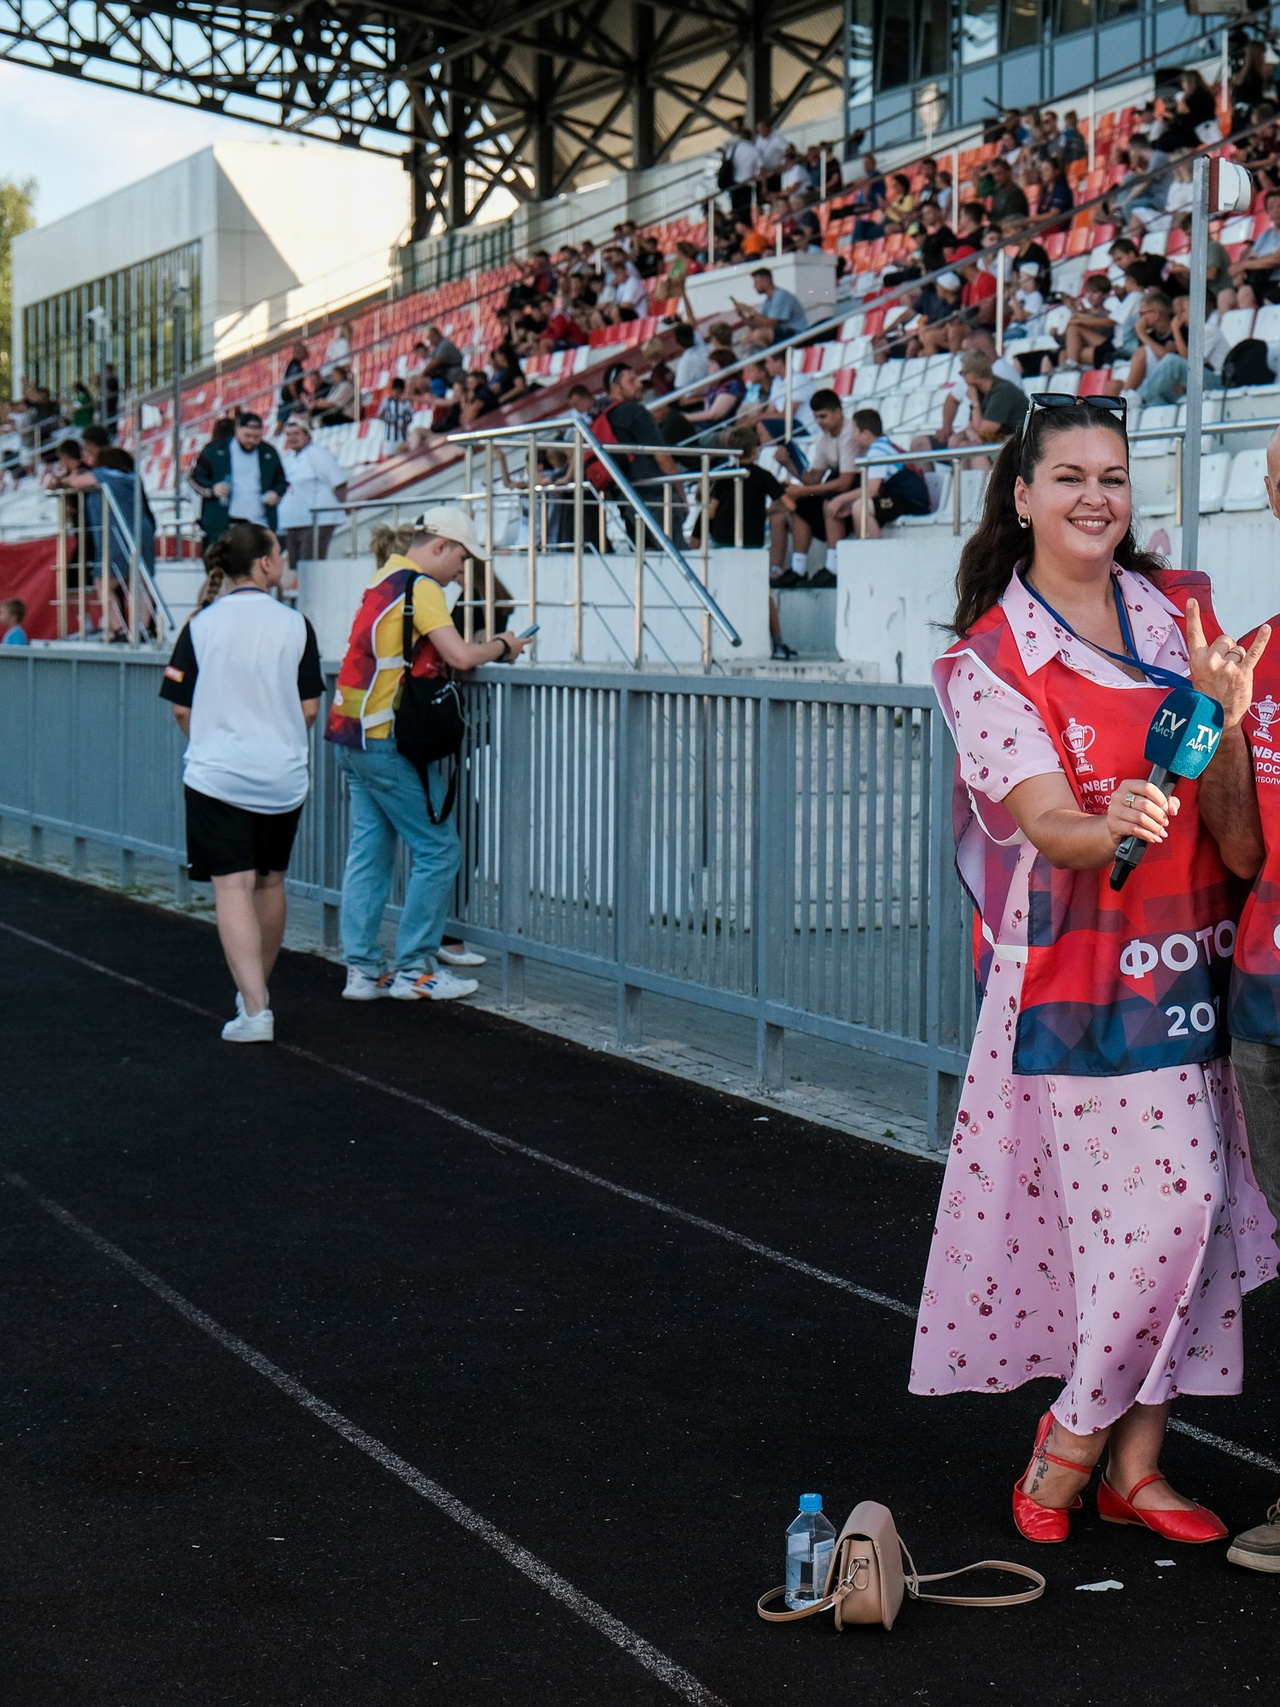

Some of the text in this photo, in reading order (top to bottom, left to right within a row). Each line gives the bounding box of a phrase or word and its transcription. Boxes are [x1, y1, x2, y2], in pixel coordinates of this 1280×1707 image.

[1159, 708, 1187, 731] TV
[1197, 724, 1219, 747] TV
[1119, 919, 1237, 979] ФОТО
